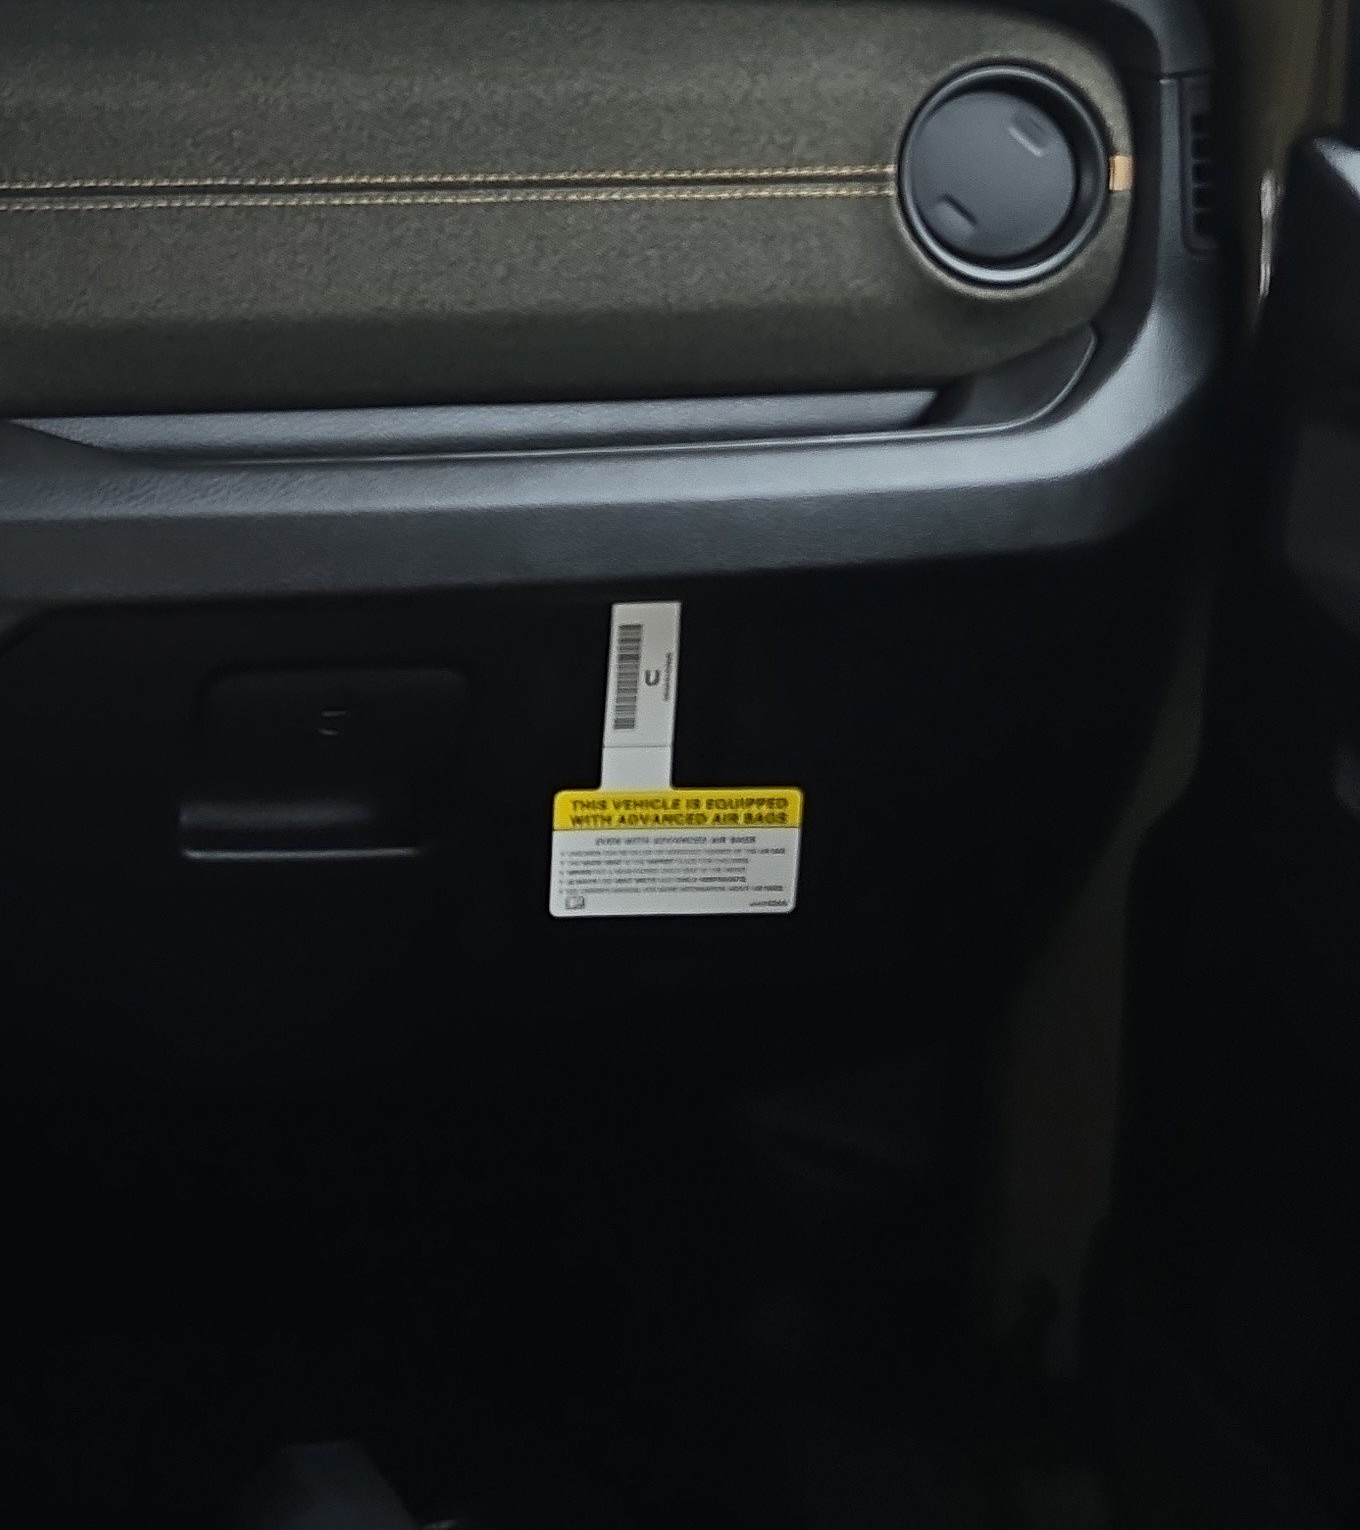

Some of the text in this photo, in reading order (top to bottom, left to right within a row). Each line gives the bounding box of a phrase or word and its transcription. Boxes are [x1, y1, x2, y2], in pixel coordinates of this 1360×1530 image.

[572, 797, 789, 811] THIS VEHICLE IS EQUIPPED
[570, 812, 789, 826] WITH ADVANCED AIR BAGS
